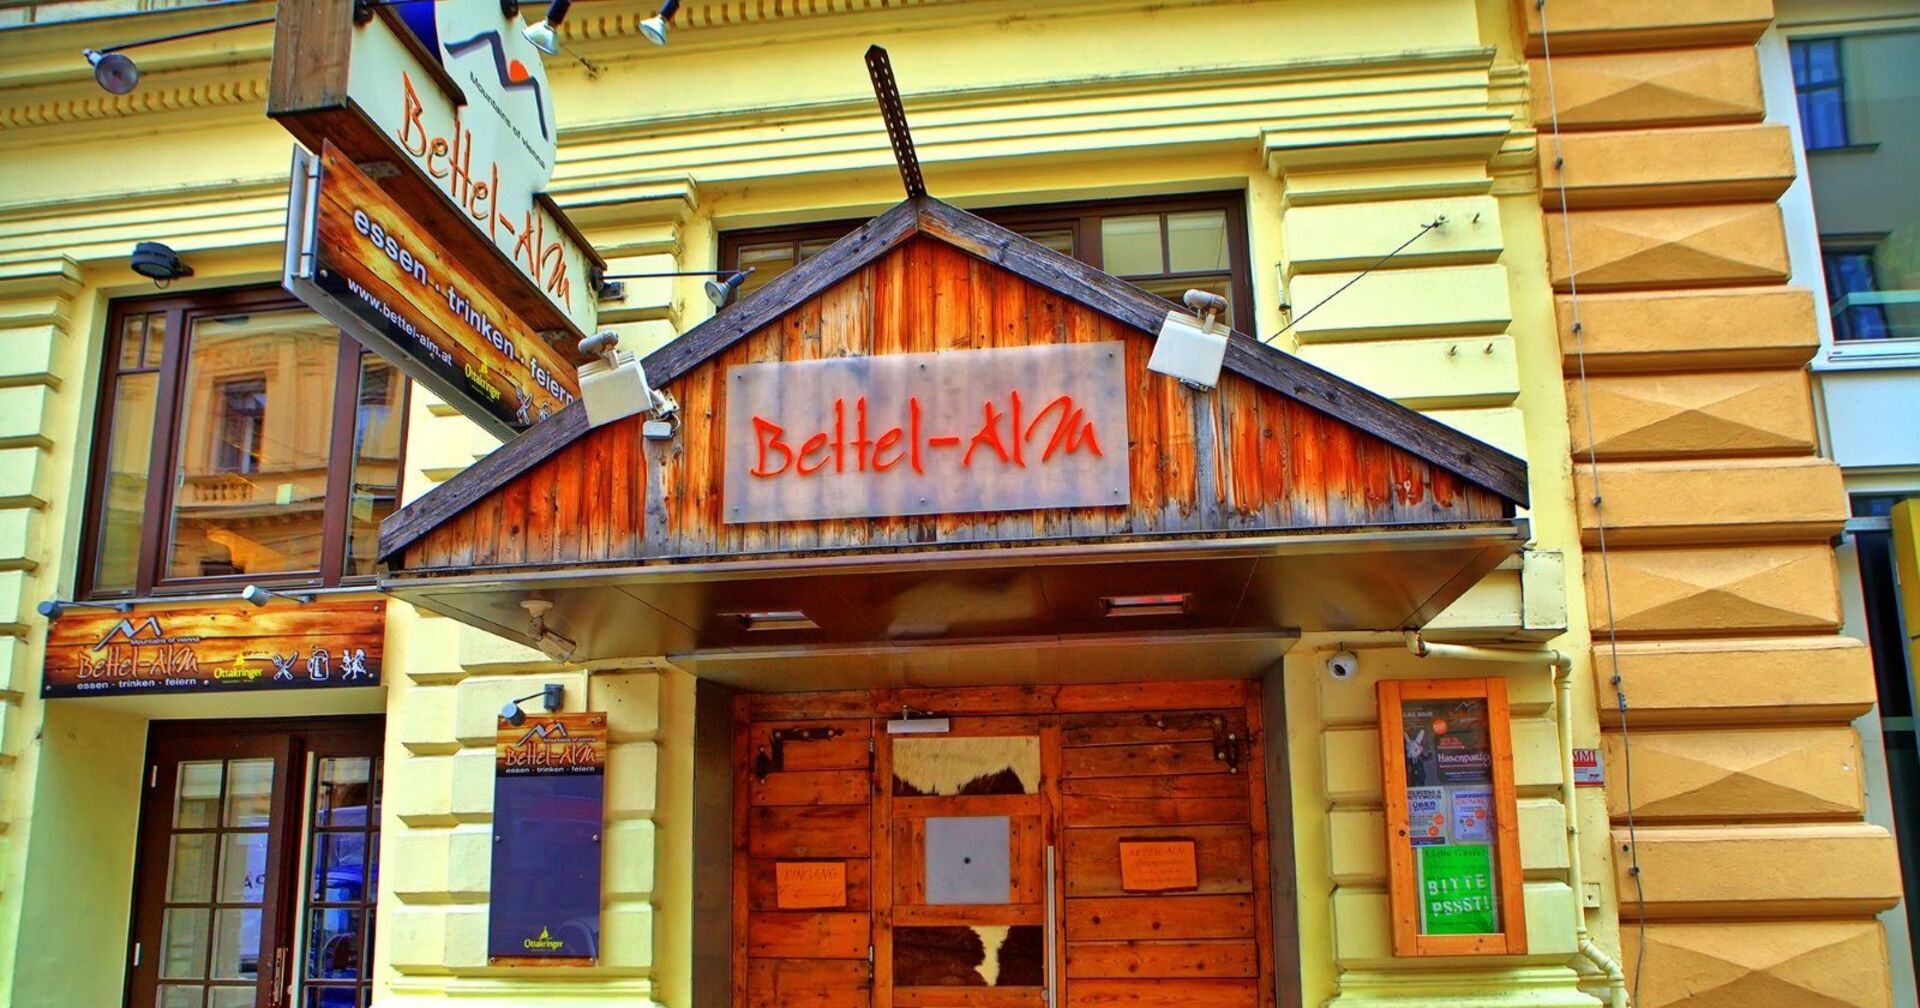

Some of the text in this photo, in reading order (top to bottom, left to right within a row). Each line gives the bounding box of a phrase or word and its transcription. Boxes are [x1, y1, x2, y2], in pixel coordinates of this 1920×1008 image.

[470, 71, 511, 128] Mountains
[513, 126, 521, 139] of
[353, 209, 575, 406] essen trinken feiern
[348, 277, 453, 366] www.bettel-alm.at
[77, 678, 197, 690] essen trinken feiern
[214, 667, 263, 680] Ottakringer
[1428, 874, 1486, 896] BITTE
[1432, 895, 1490, 918] PSSST!
